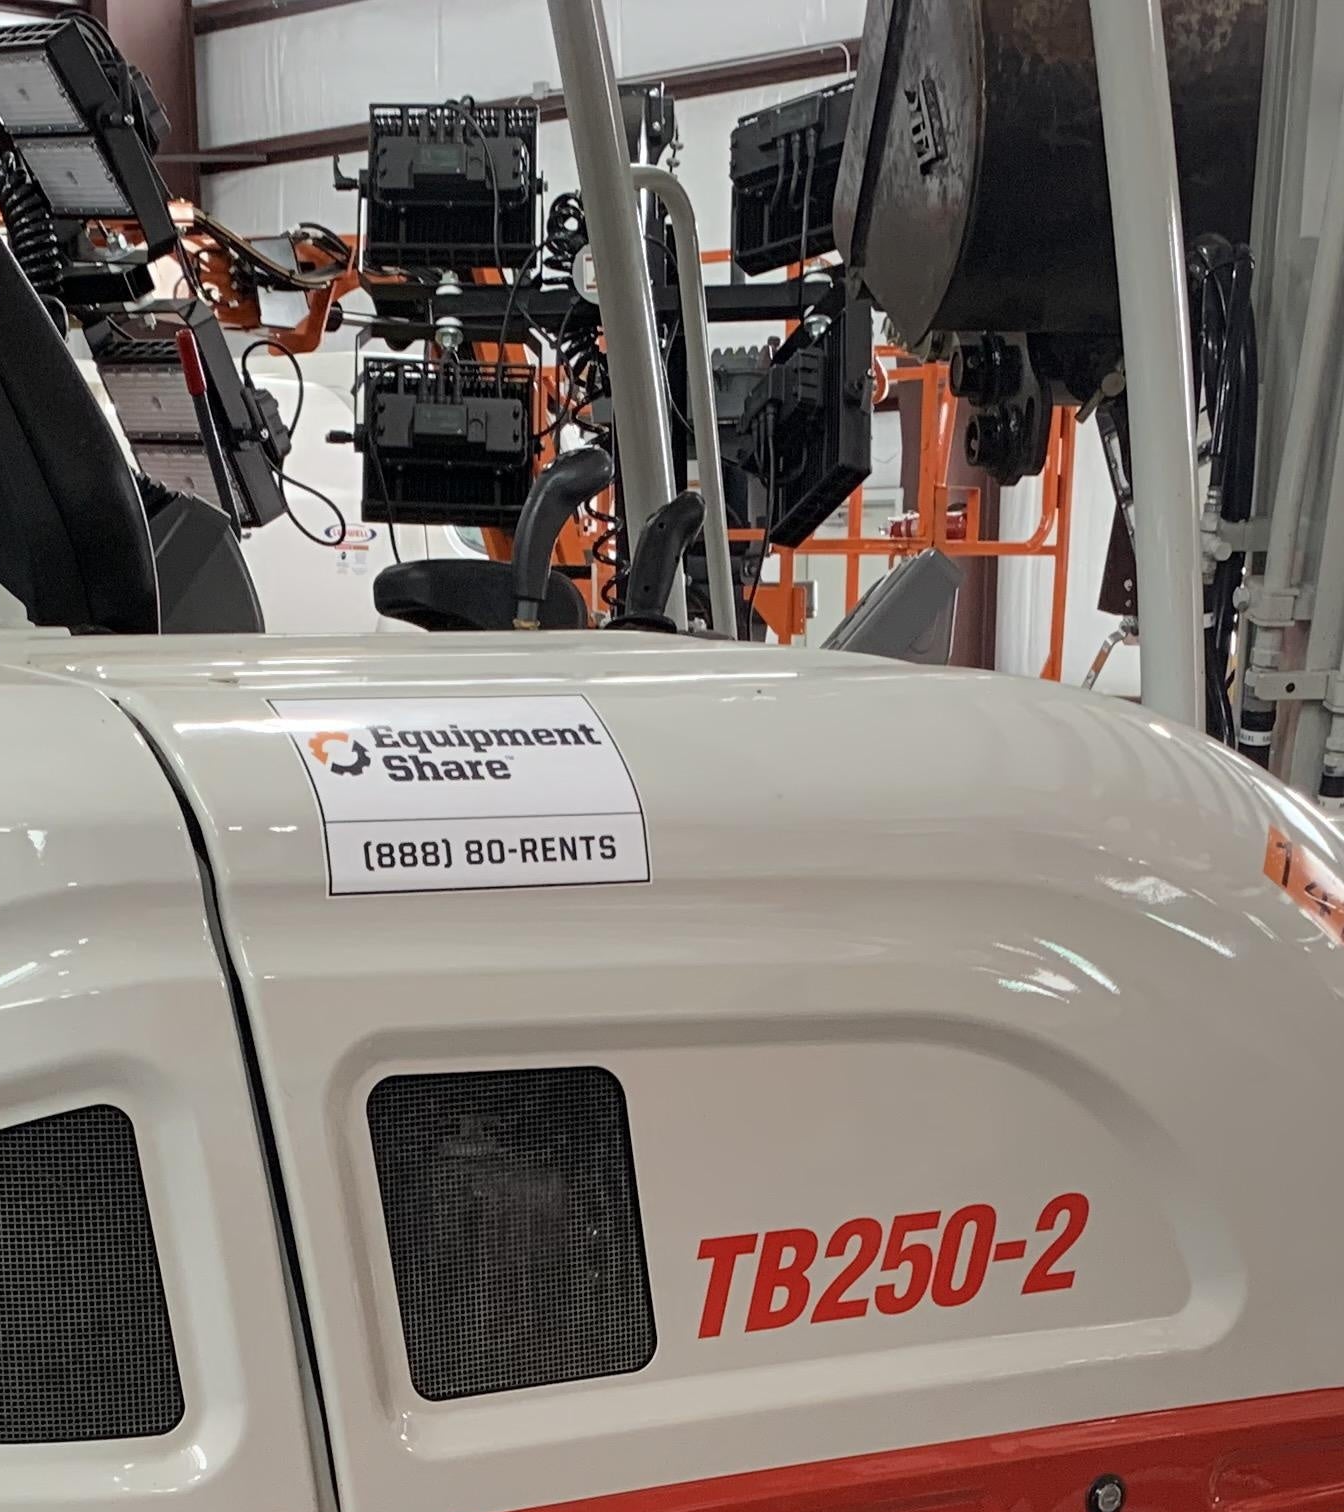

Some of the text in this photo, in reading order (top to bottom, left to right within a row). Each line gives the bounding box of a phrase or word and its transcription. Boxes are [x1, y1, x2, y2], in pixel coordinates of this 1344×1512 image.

[367, 724, 602, 753] Equipment
[383, 755, 512, 783] Share
[363, 834, 618, 871] (888) 80-RENTS
[696, 1192, 1090, 1340] TB250-2
